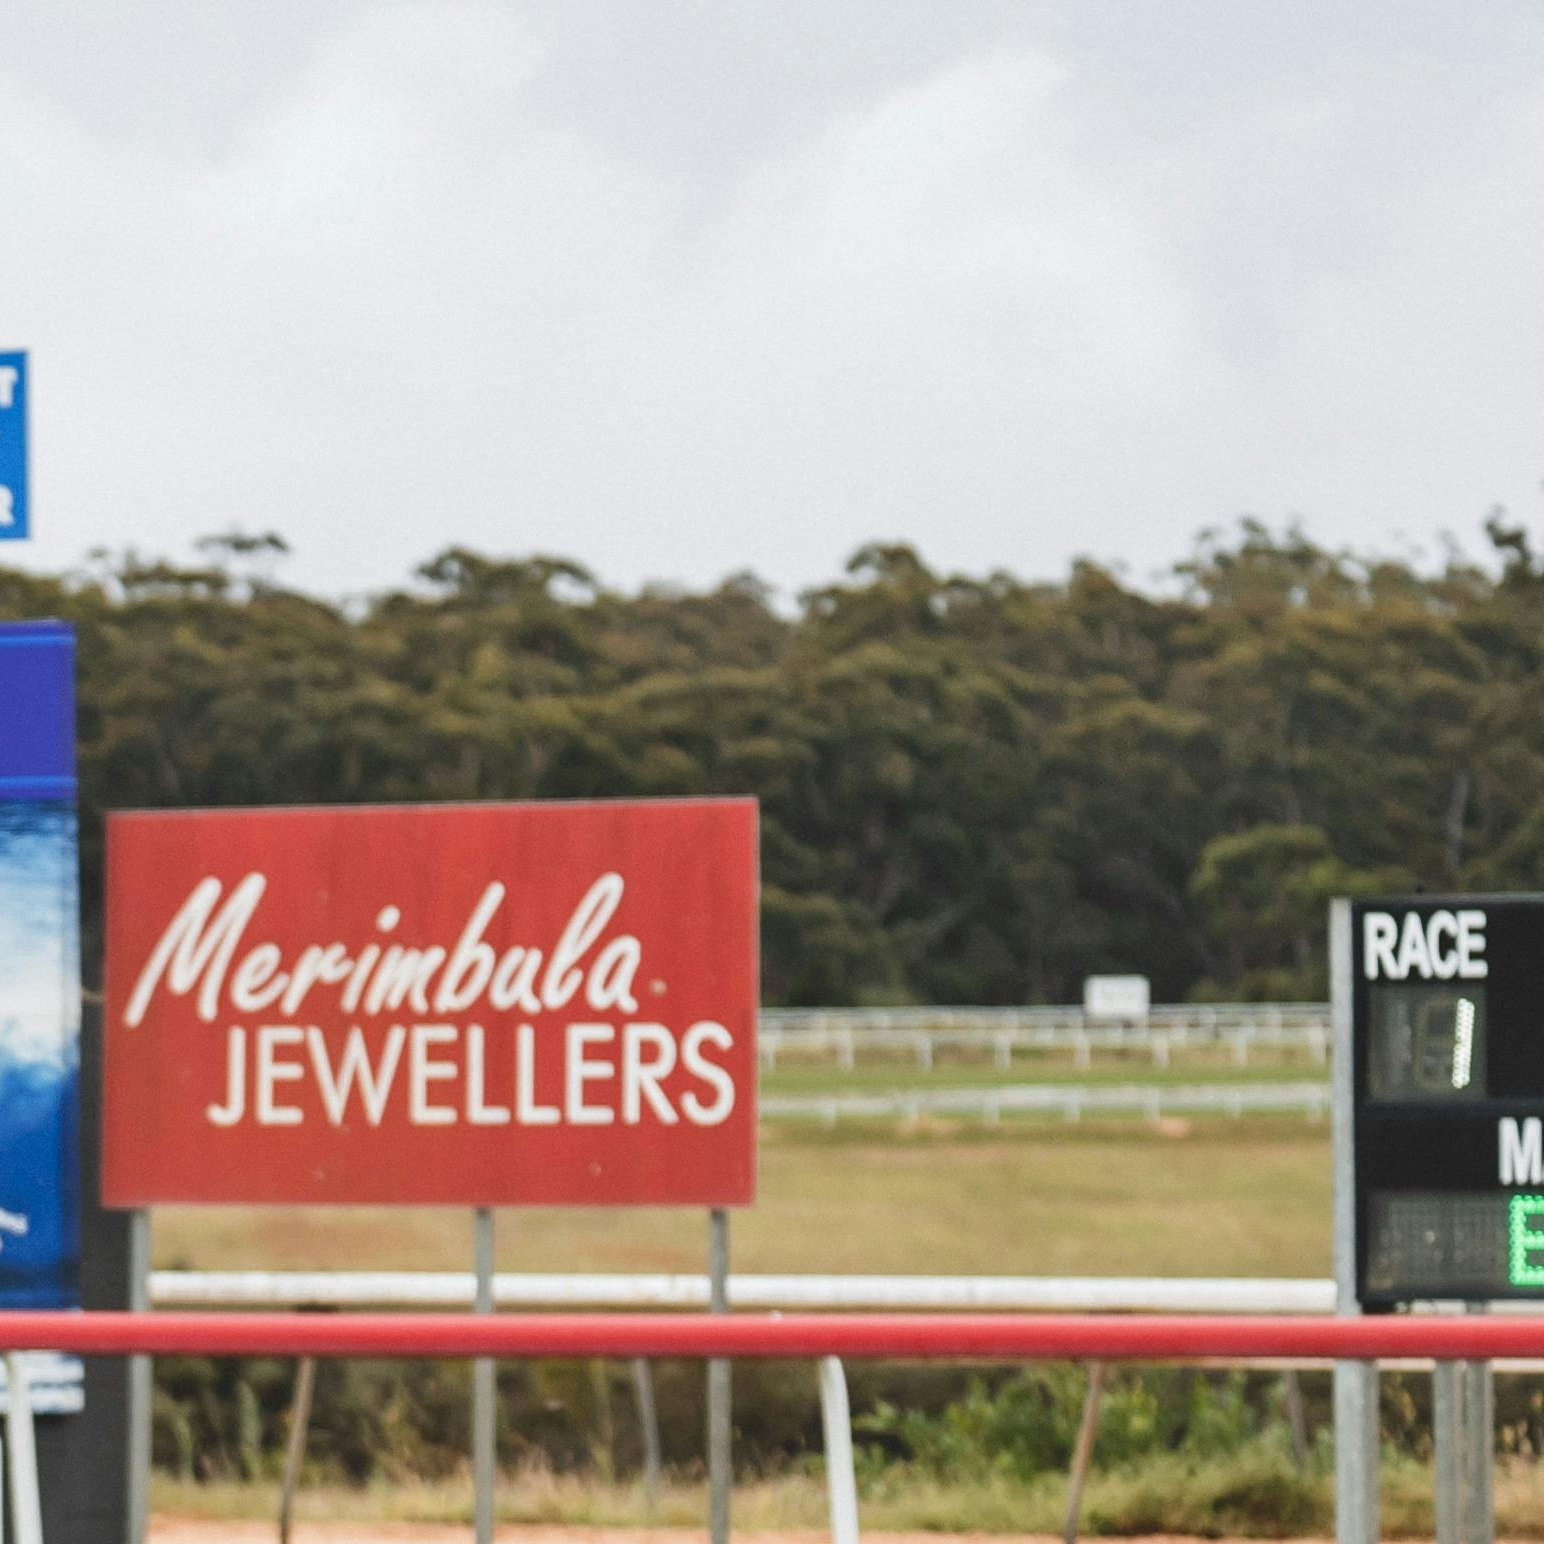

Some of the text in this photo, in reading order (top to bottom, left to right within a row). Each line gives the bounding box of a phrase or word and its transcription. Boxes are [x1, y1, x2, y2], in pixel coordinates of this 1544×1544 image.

[123, 870, 641, 1030] Merimbula
[1363, 909, 1489, 981] RACE
[205, 1021, 738, 1129] JEWELLERS
[1451, 998, 1476, 1089] 1
[1498, 1116, 1544, 1186] M
